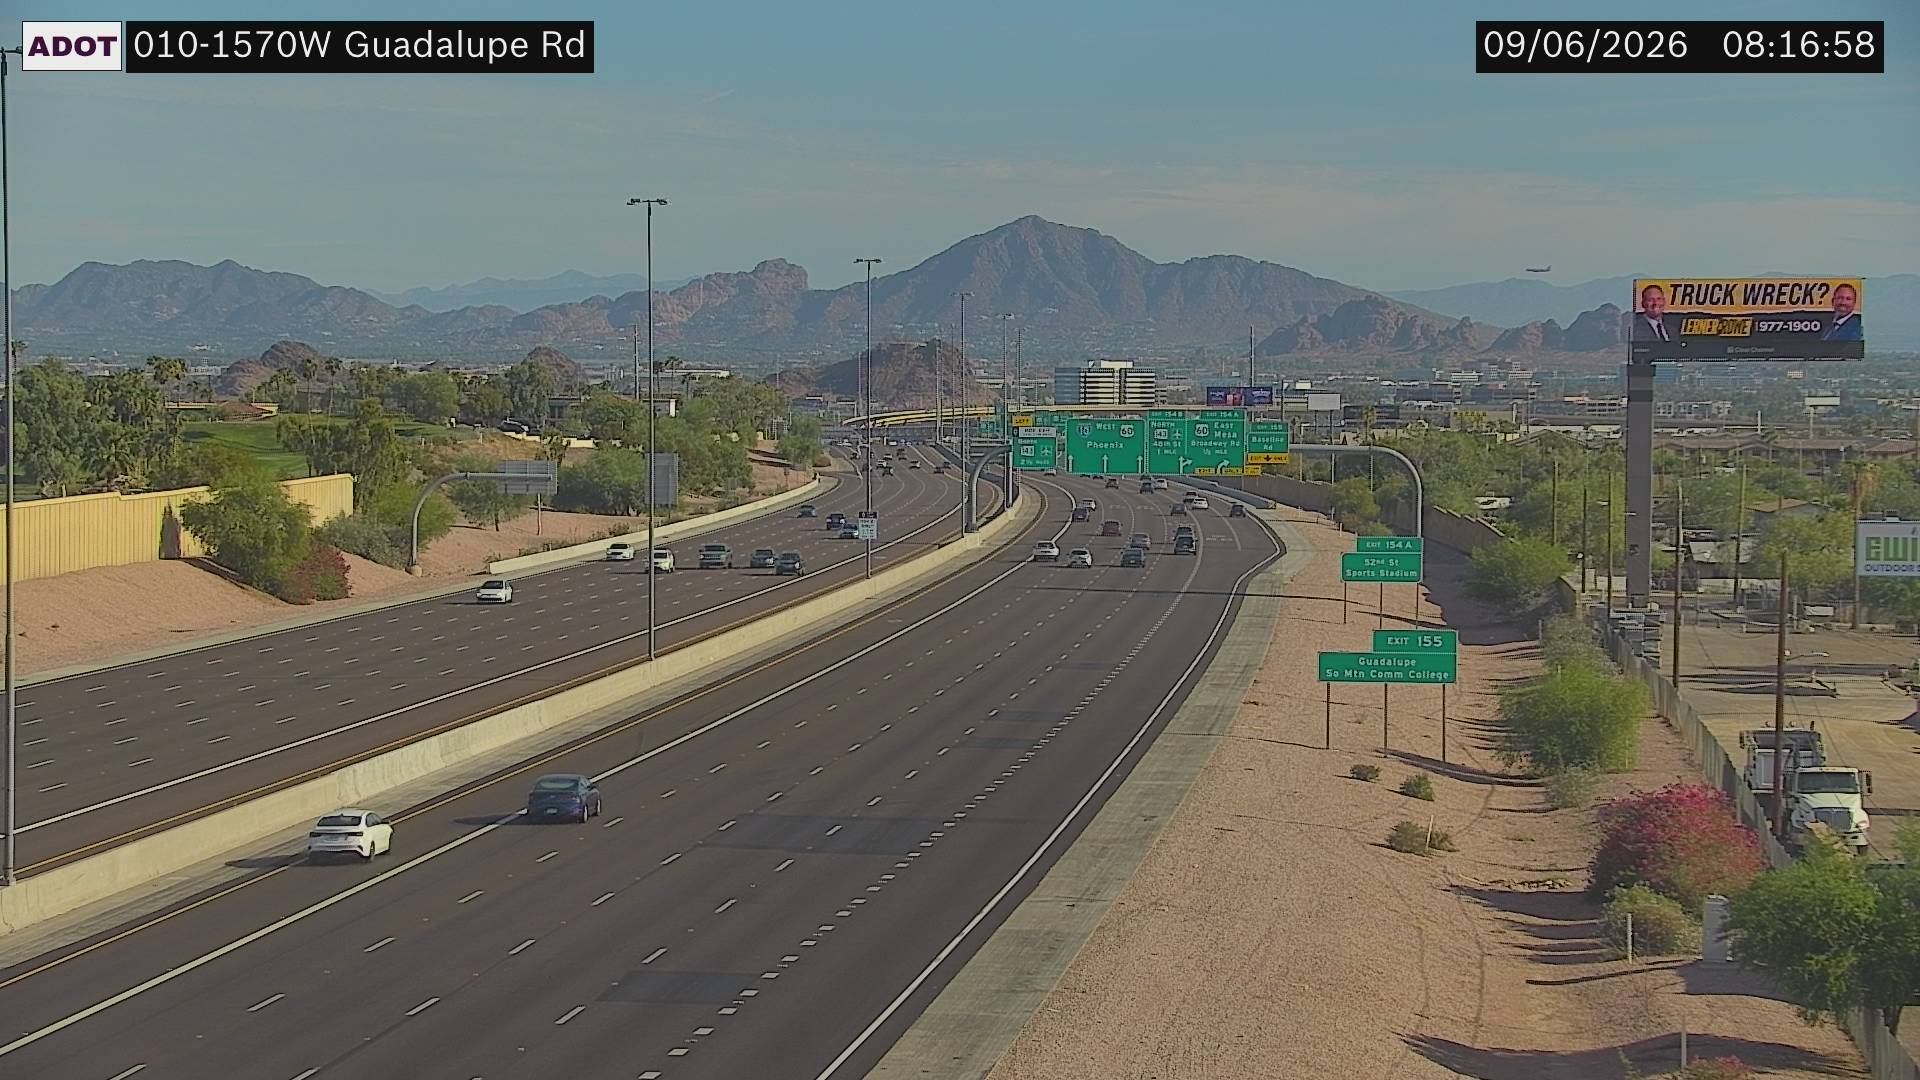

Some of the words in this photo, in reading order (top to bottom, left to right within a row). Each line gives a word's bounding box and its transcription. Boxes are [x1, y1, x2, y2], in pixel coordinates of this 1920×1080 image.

[1670, 283, 1736, 305] TRUCK
[1741, 282, 1829, 305] WRECK?
[1759, 320, 1821, 332] 977-1900
[1121, 427, 1134, 436] 60
[1196, 426, 1209, 434] 60
[1086, 441, 1124, 449] Phoenix
[1386, 541, 1402, 549] 154
[1405, 541, 1413, 549] A
[1364, 558, 1385, 566] 52nd
[1389, 558, 1400, 566] St
[1864, 564, 1915, 572] OUTDOOR
[1345, 569, 1376, 577] Sports
[1380, 569, 1417, 577] Stadium
[1387, 636, 1410, 645] EXIT
[1418, 636, 1443, 647] 155
[1358, 657, 1417, 668] Guadalupe
[1326, 669, 1339, 678] So
[1344, 669, 1365, 678] Mtn
[1370, 669, 1404, 678] Comm
[1408, 670, 1449, 681] College
